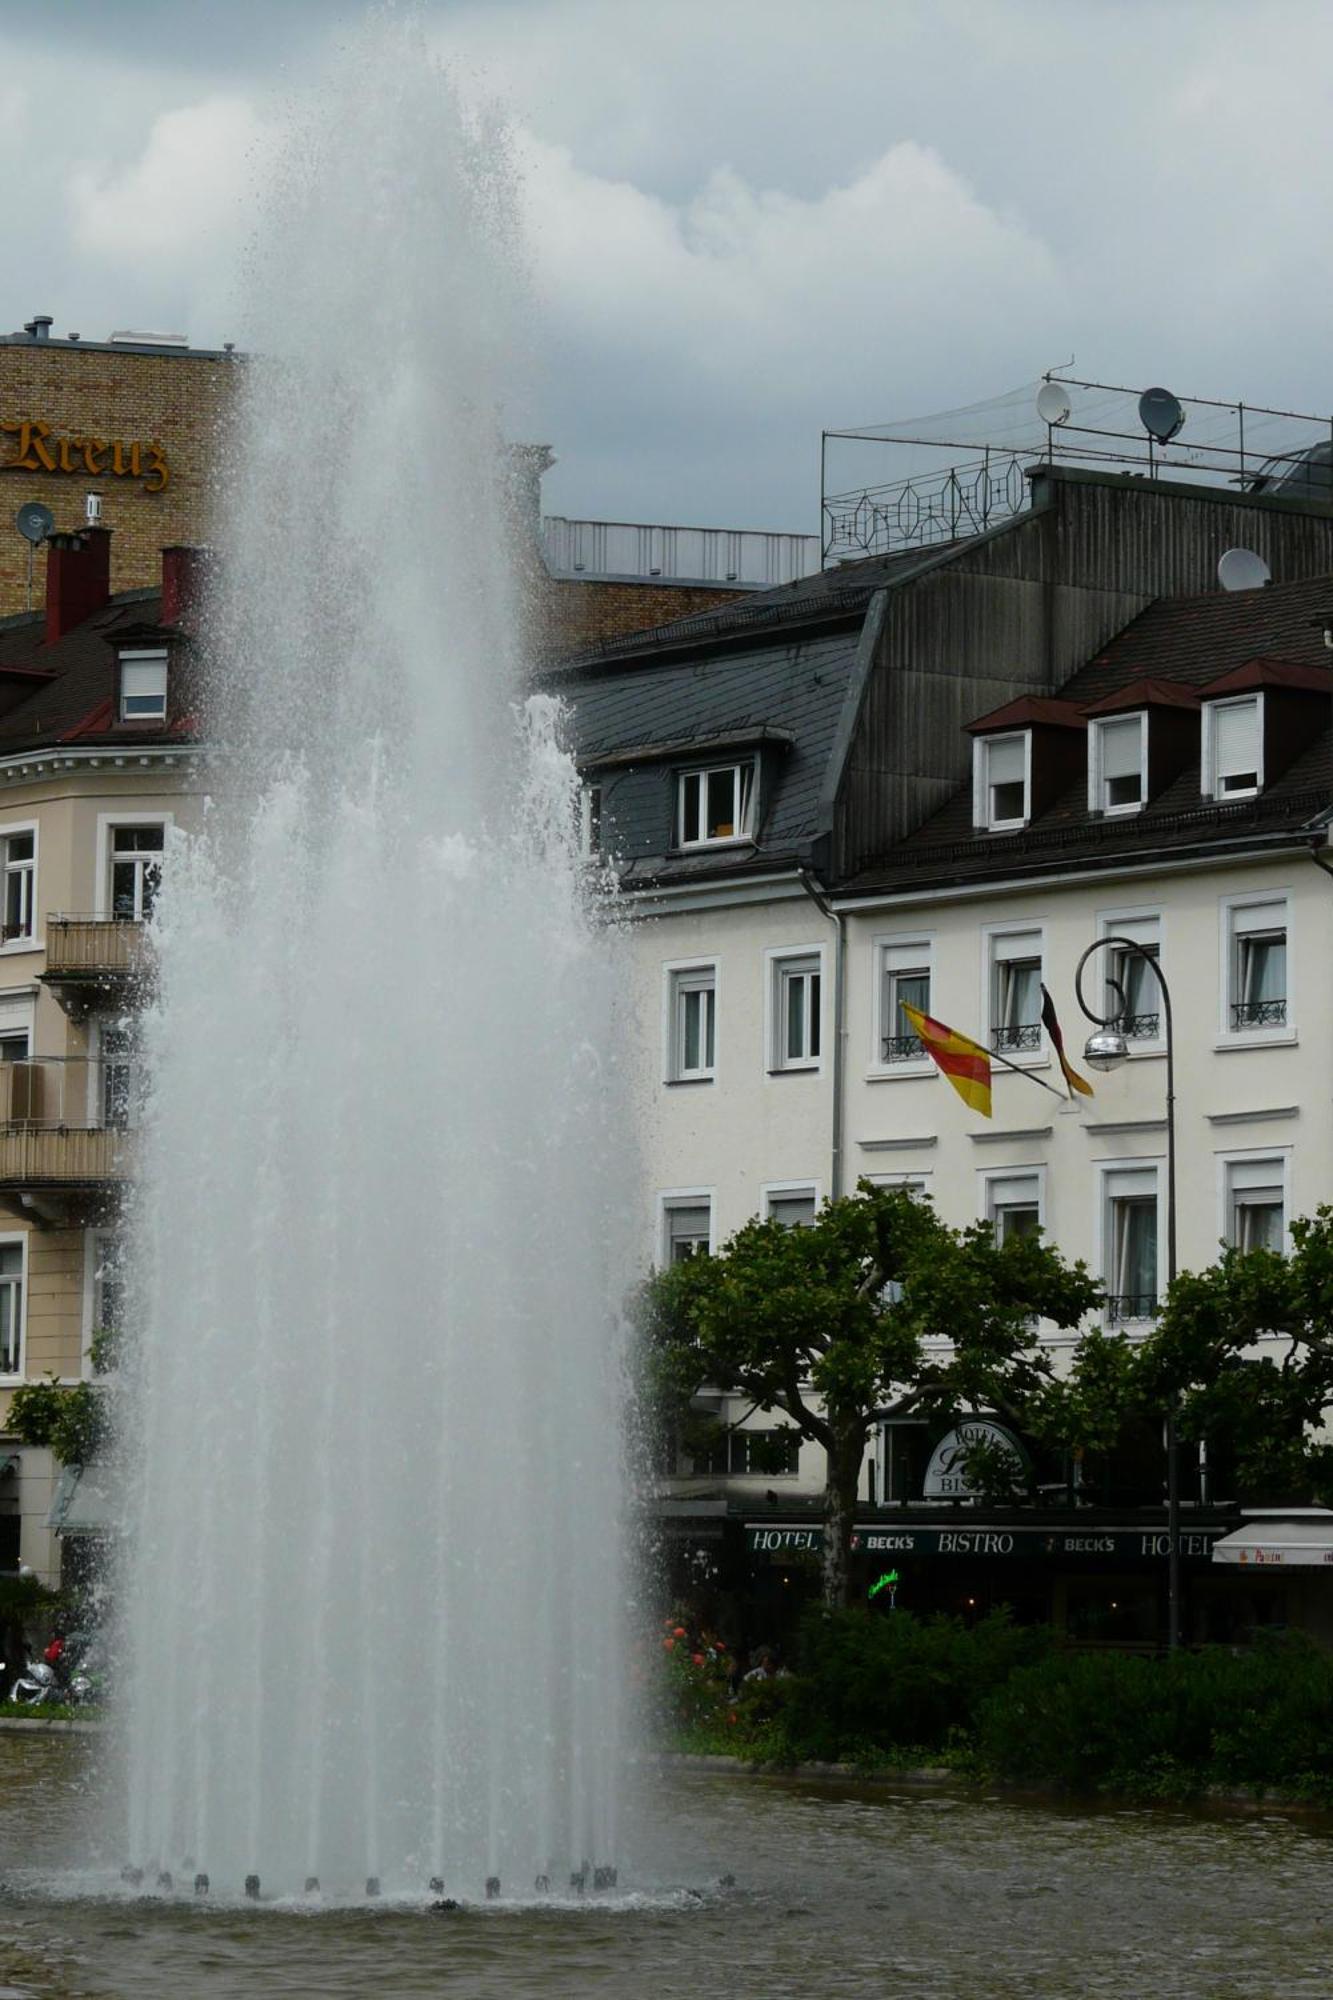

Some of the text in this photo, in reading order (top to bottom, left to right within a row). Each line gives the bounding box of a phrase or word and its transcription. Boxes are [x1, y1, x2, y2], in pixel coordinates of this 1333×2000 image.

[0, 420, 170, 492] Kreuz
[753, 1530, 1213, 1556] HOTEL BECK'S BISTRO BECK'S HOTEL
